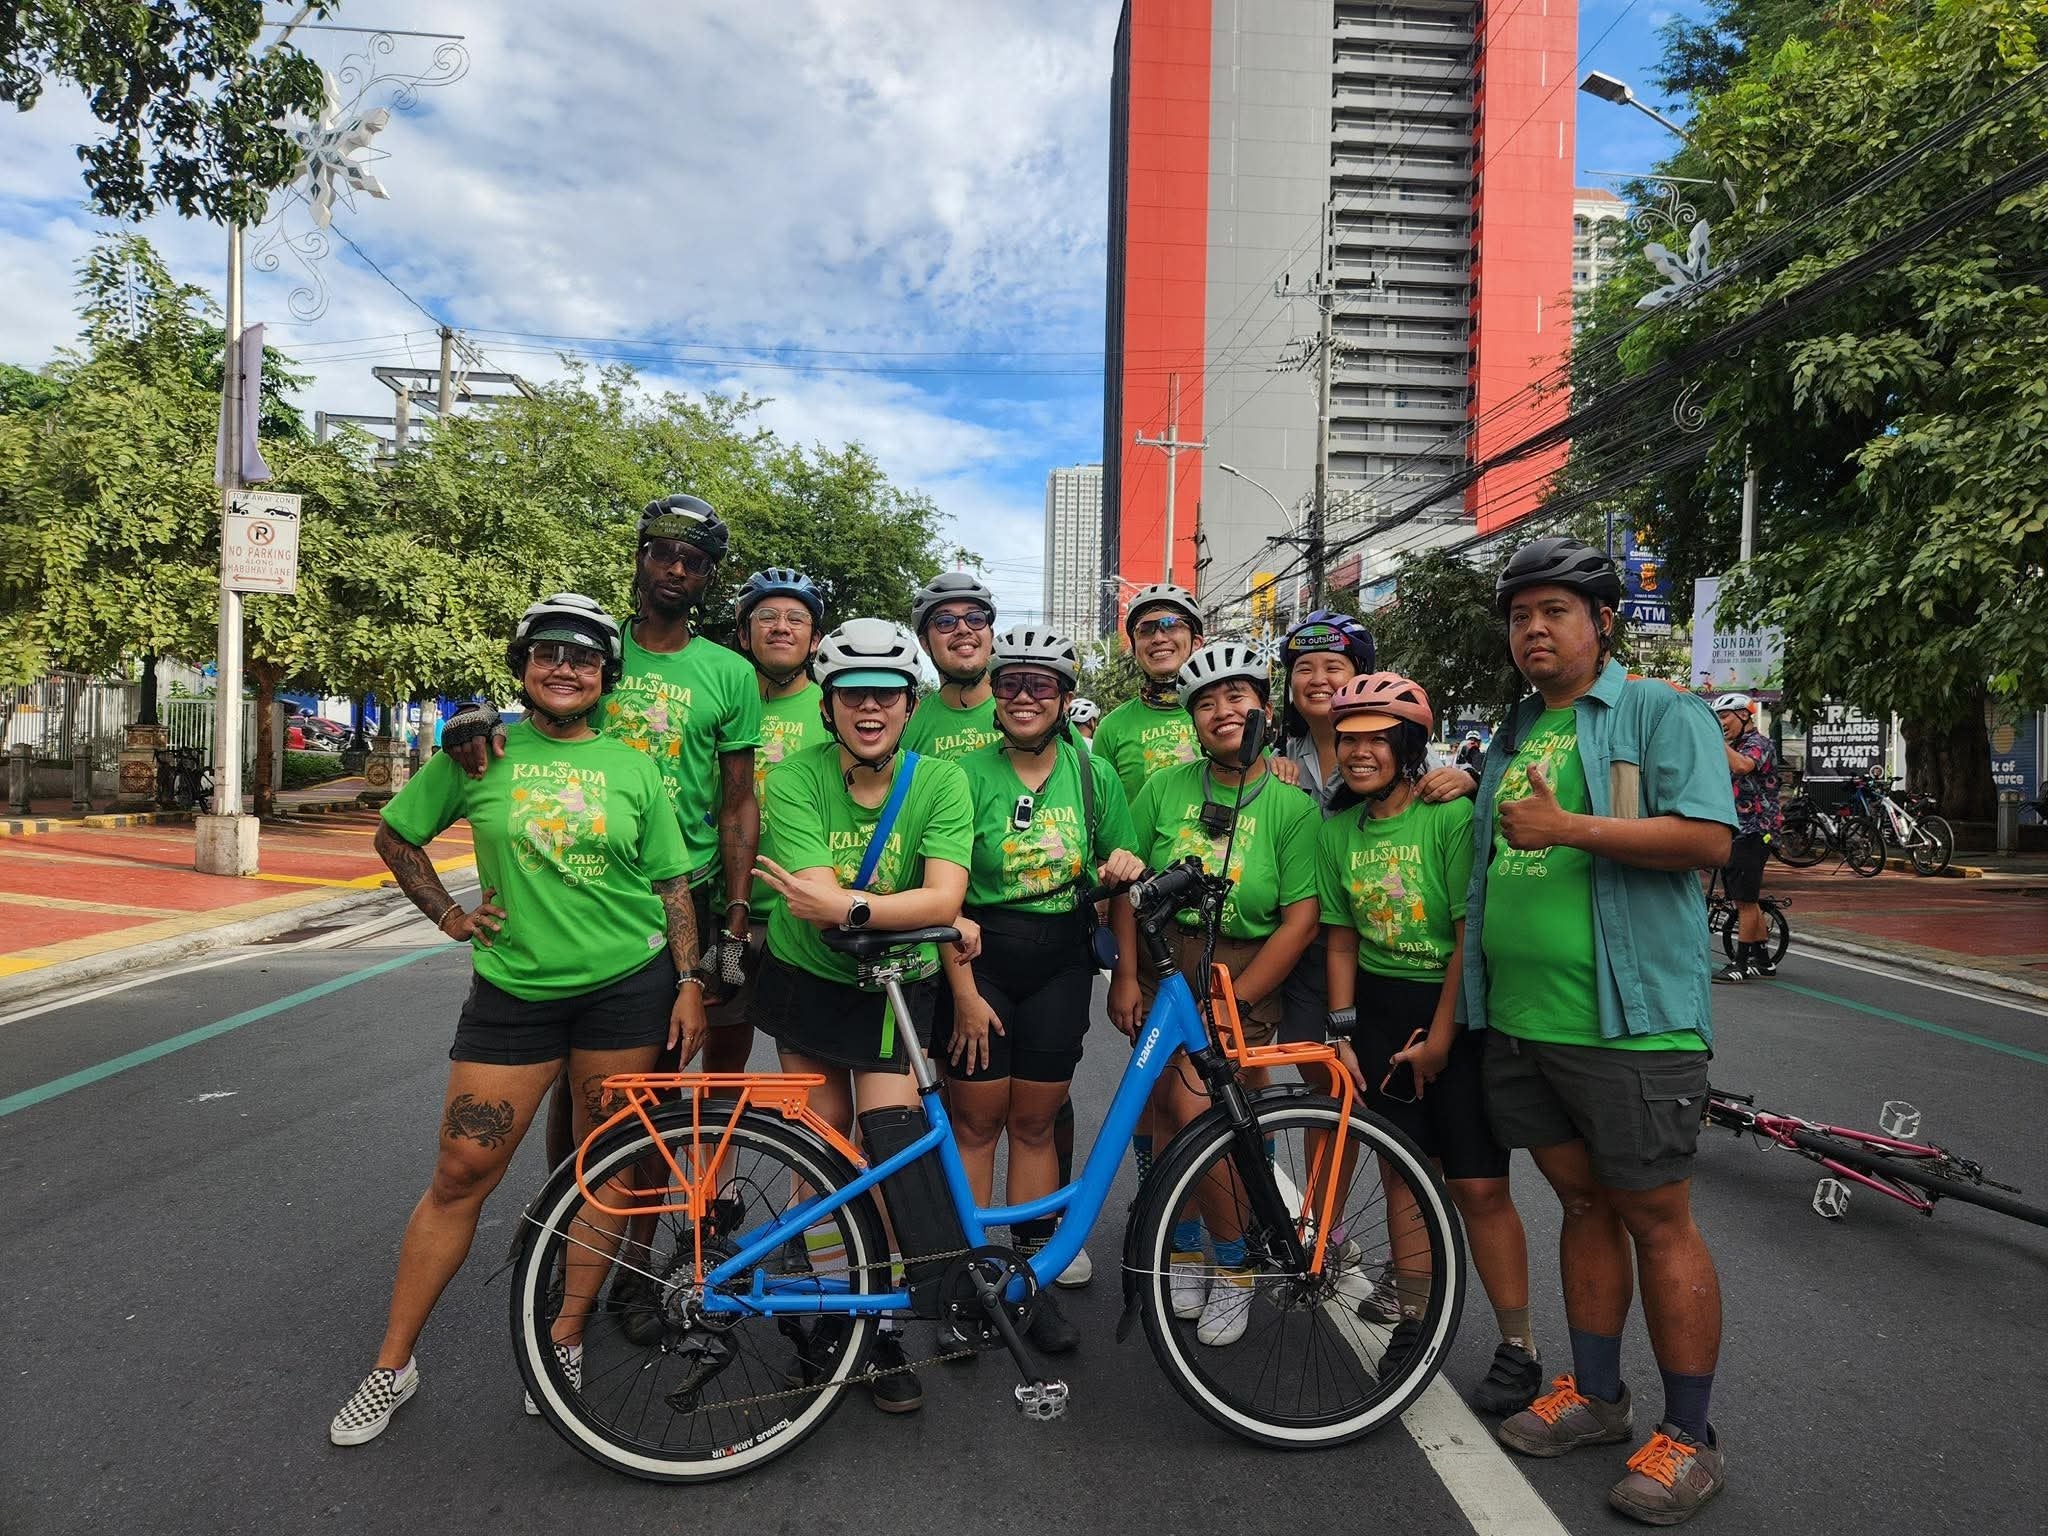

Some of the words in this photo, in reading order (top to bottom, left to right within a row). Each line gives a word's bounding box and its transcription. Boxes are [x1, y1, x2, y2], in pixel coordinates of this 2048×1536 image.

[232, 492, 250, 501] TOW
[252, 494, 273, 502] AWAY
[277, 496, 296, 505] ZONE
[228, 545, 242, 557] NO
[248, 547, 292, 561] PARKING
[227, 563, 267, 575] MABUHAY
[270, 568, 291, 576] LANE
[1631, 606, 1665, 621] ATM
[1307, 633, 1340, 644] outside
[1712, 637, 1763, 650] SUNDAY
[1712, 650, 1720, 658] OF
[1739, 649, 1762, 657] MONTH
[645, 672, 662, 680] ANO
[616, 675, 692, 707] ALSADA
[1812, 723, 1879, 736] BILLIARDS
[1811, 745, 1828, 757] DJ
[1830, 745, 1880, 757] STARTS
[1821, 757, 1839, 768] AT
[1840, 757, 1868, 768] 7PM
[2001, 761, 2016, 772] of
[512, 763, 606, 788] KALSADA
[860, 823, 876, 833] ANO
[1376, 840, 1392, 848] ANO
[567, 853, 605, 865] PARA
[1351, 845, 1422, 871] KALSADA
[575, 863, 610, 877] TAO!
[1399, 940, 1435, 952] PARA
[1136, 1027, 1160, 1069] nakto
[711, 1438, 754, 1459] ARMOUR
